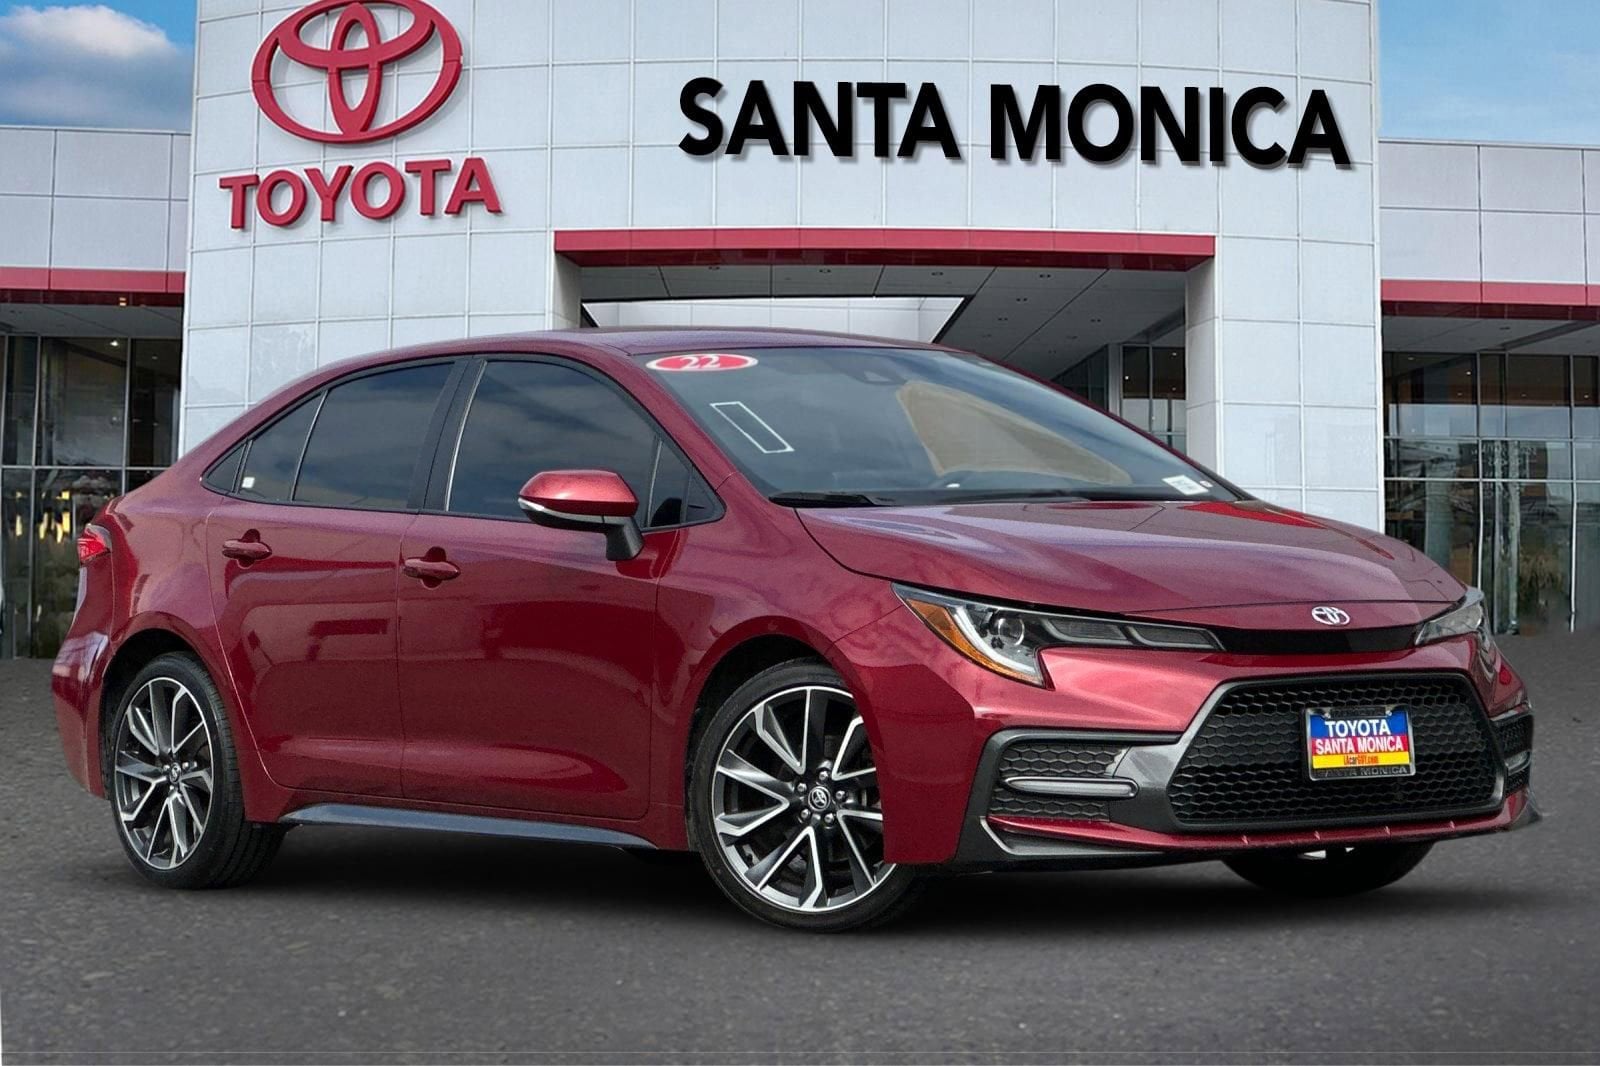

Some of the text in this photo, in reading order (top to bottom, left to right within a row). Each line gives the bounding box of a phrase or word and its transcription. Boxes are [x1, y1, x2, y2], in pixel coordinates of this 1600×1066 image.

[678, 77, 1352, 167] SANTA MONICA
[219, 157, 502, 229] TOYOTA
[680, 354, 720, 369] 22
[1325, 719, 1391, 737] TOYOTA
[1316, 736, 1403, 754] SANTA MONICA
[1360, 766, 1407, 776] MONICA
